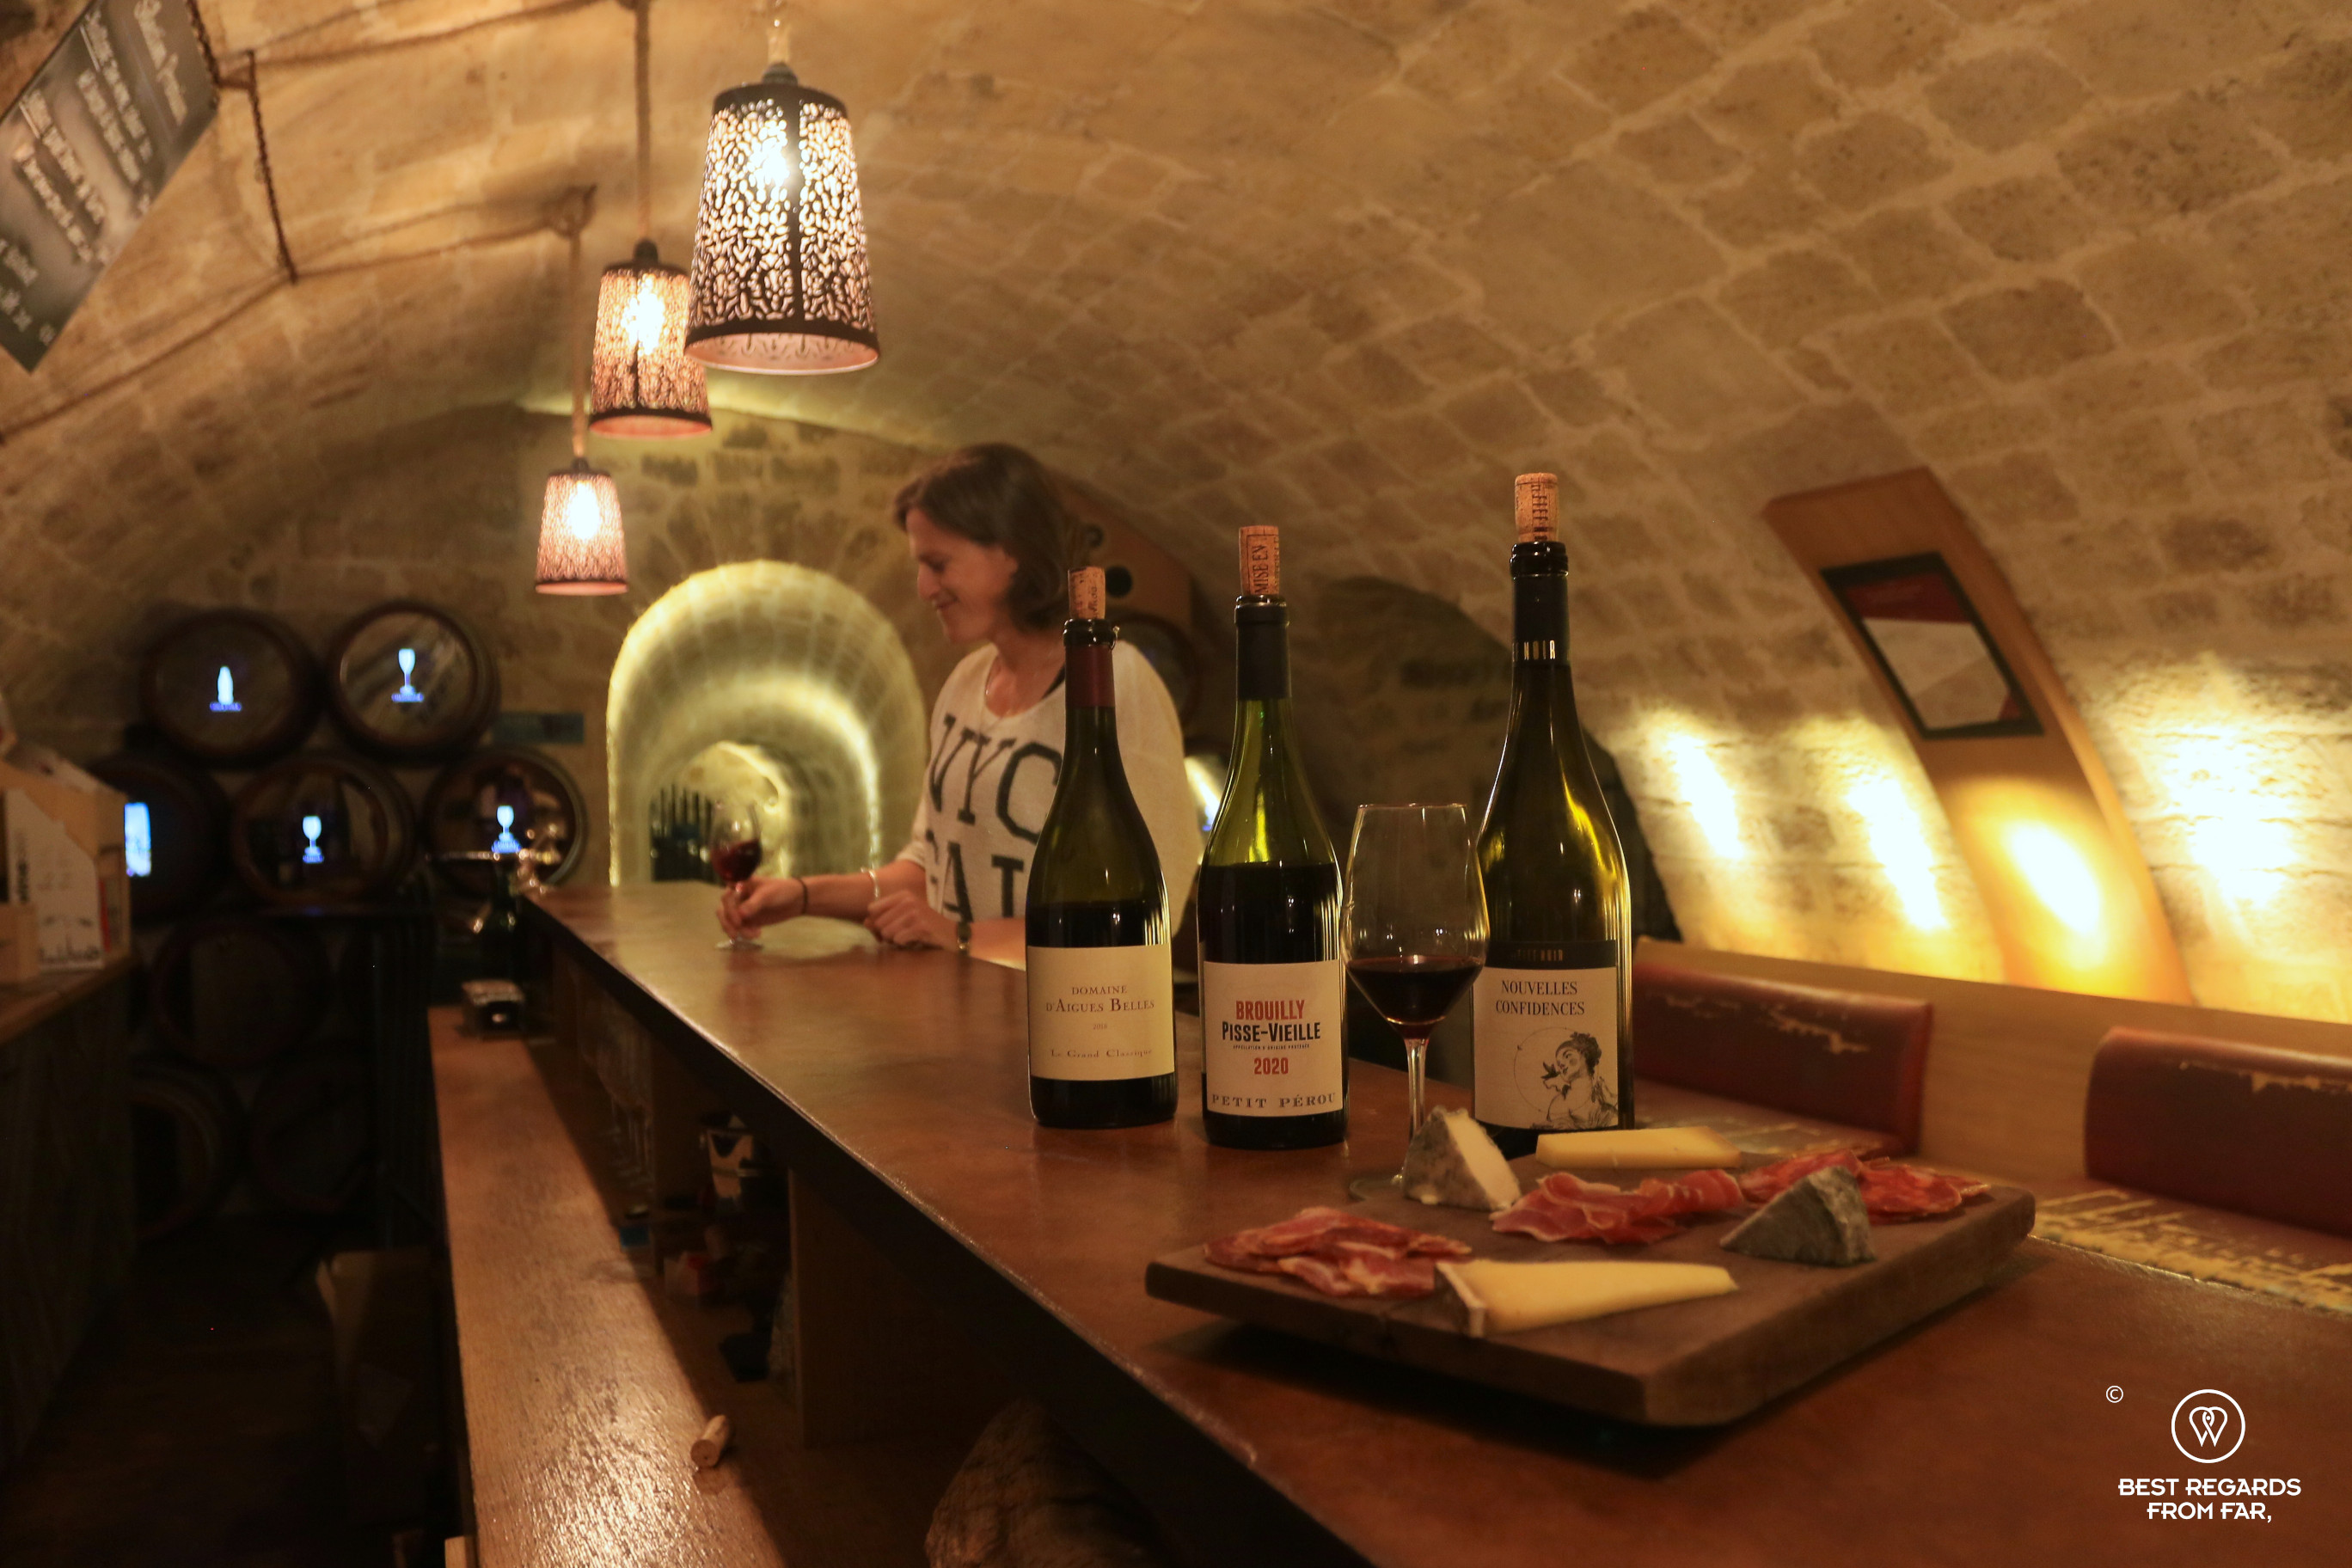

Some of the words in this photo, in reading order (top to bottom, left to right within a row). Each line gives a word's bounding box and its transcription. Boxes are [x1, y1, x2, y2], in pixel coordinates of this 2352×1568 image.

[1253, 544, 1268, 560] EN
[1253, 564, 1269, 595] MISE
[1071, 985, 1128, 995] DOMAINE
[1502, 980, 1578, 995] NOUVELLES
[1110, 997, 1155, 1012] BELLES
[1235, 1000, 1306, 1021] BROUILLY
[1495, 1000, 1585, 1016] CONFIDENCES
[1222, 1020, 1321, 1043] PISSE-VIEILLE
[1067, 1049, 1099, 1058] Grand
[1253, 1057, 1289, 1075] 2020
[1211, 1093, 1267, 1109] PETIT
[1278, 1093, 1337, 1109] PÉROU
